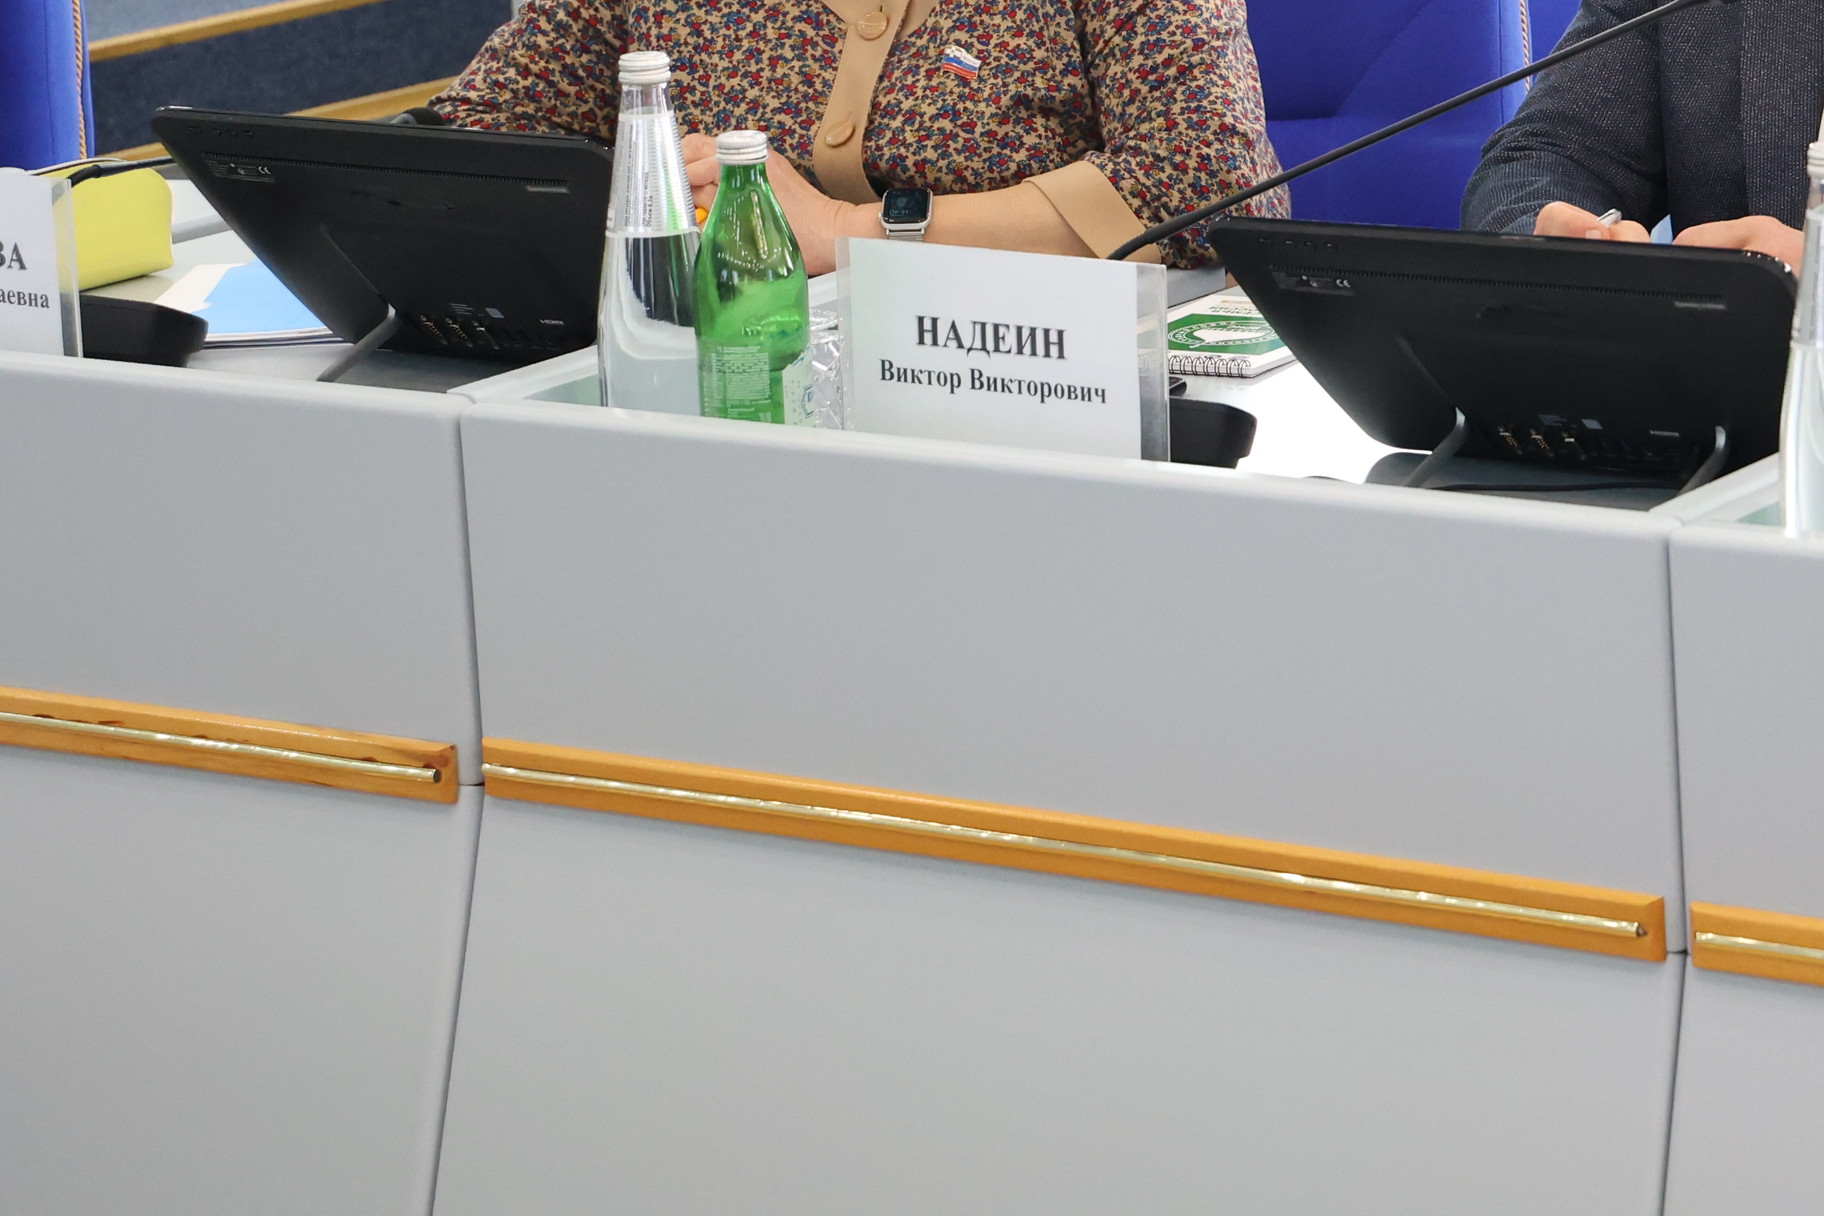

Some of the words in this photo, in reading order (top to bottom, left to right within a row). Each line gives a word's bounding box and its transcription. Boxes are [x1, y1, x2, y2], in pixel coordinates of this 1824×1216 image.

[914, 315, 1067, 360] НАДЕИН
[880, 359, 962, 394] Виктор
[969, 368, 1107, 404] Викторович
